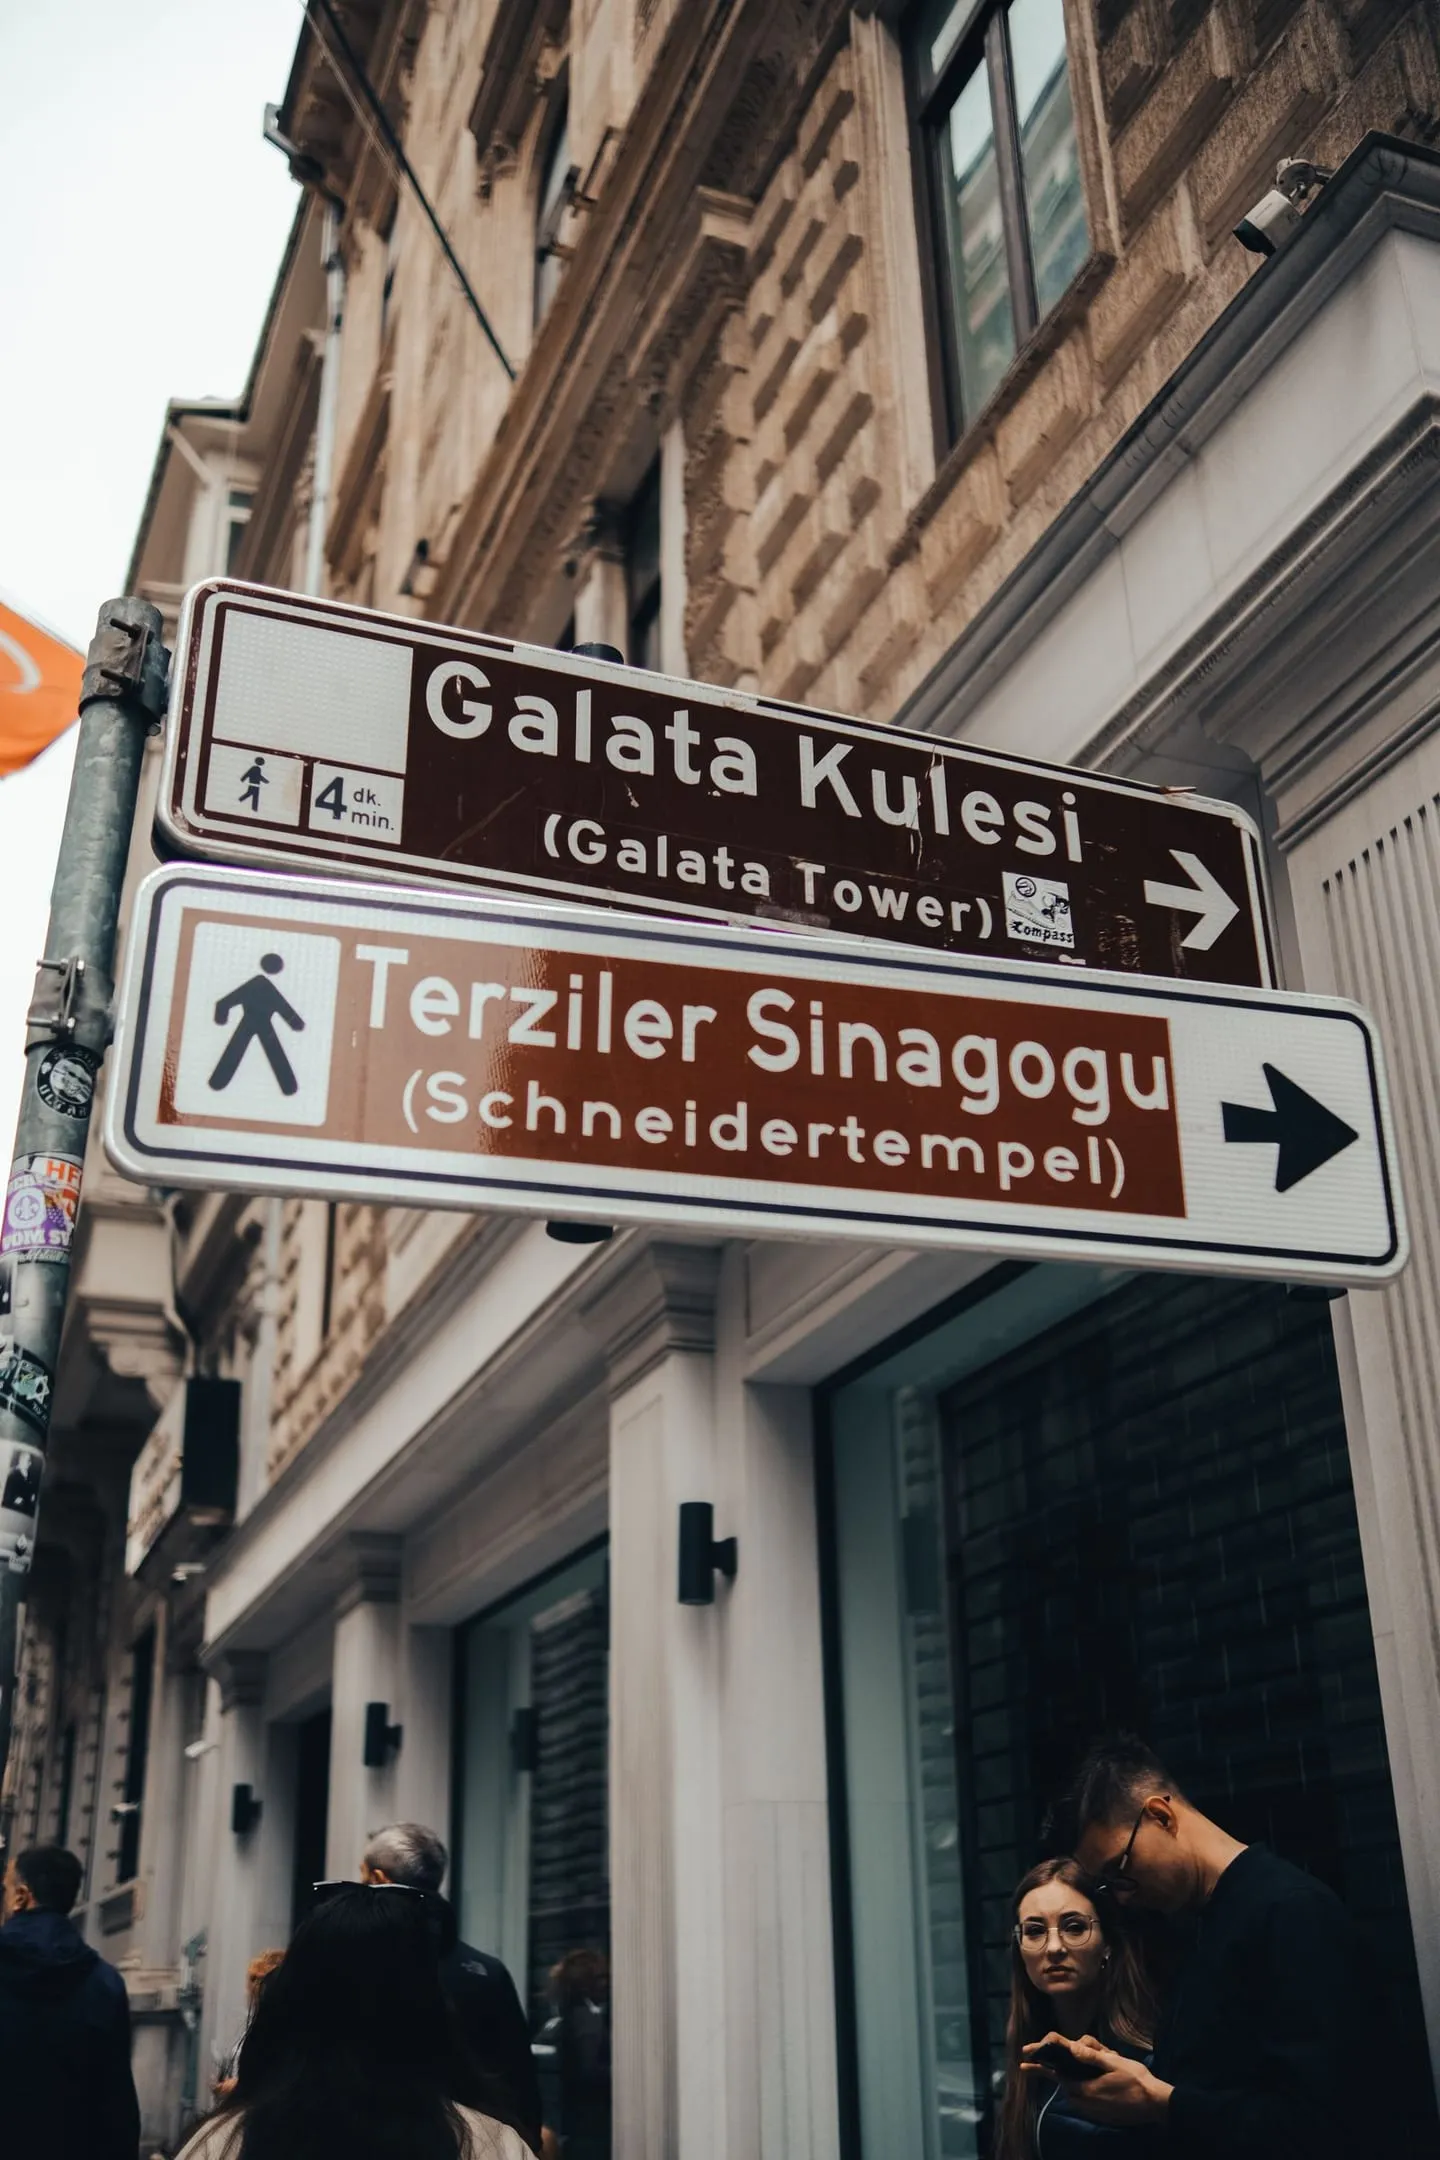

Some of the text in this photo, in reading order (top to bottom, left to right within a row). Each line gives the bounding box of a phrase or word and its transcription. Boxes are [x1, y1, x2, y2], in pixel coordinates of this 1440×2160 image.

[315, 776, 348, 821] 4
[351, 811, 394, 831] min.
[353, 788, 381, 807] dk.
[426, 661, 1083, 863] Galata Kulesi
[543, 813, 993, 939] (Galata Tower)
[354, 943, 1169, 1126] Terziler Sinagogu
[402, 1068, 1125, 1198] (Schneidertempel)
